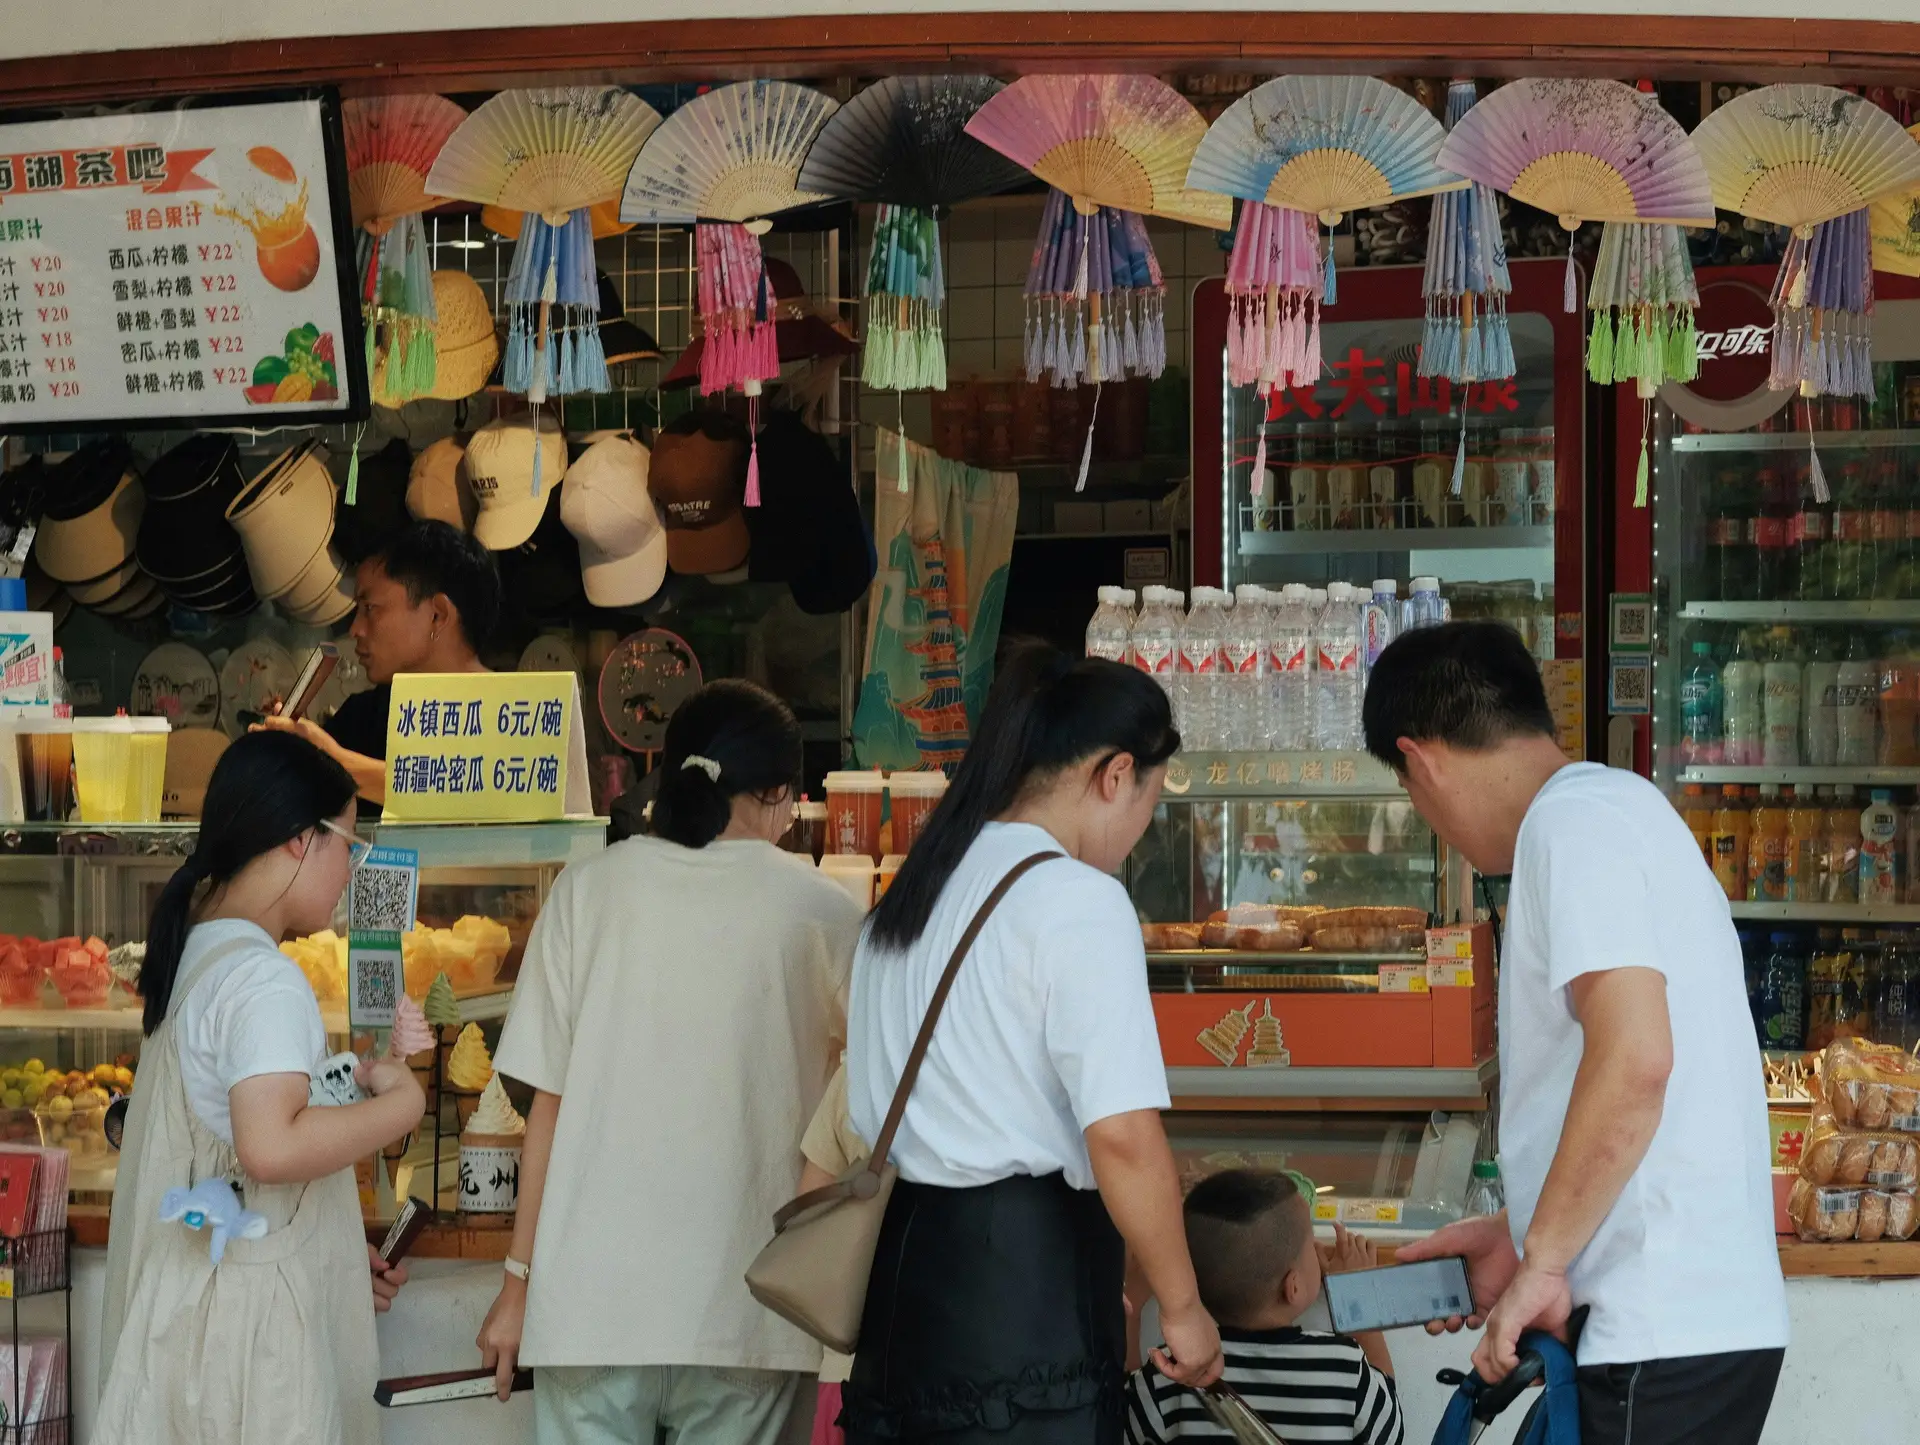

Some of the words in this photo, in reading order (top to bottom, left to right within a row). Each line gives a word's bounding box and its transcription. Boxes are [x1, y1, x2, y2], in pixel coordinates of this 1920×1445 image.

[126, 205, 202, 232] 混合果汁
[31, 256, 62, 272] ¥20
[109, 243, 189, 270] 西瓜+柠檬
[198, 244, 233, 261] ¥22
[34, 281, 65, 297] ¥20
[201, 274, 236, 292] ¥22
[0, 307, 23, 327] 汁
[38, 306, 69, 322] ¥20
[205, 305, 240, 323] ¥22
[41, 331, 72, 348] ¥18
[208, 336, 243, 353] ¥22
[1695, 324, 1776, 360] 口可乐
[45, 356, 76, 373] ¥18
[213, 367, 247, 384] ¥22
[48, 381, 80, 398] ¥20
[0, 651, 47, 691] 更便宜!
[397, 699, 482, 737] 冰镇西瓜
[498, 698, 563, 737] 6元/碗
[392, 755, 484, 794] 新疆哈密瓜
[493, 754, 559, 794] 6元/碗
[1888, 984, 1904, 1016] 纯悦
